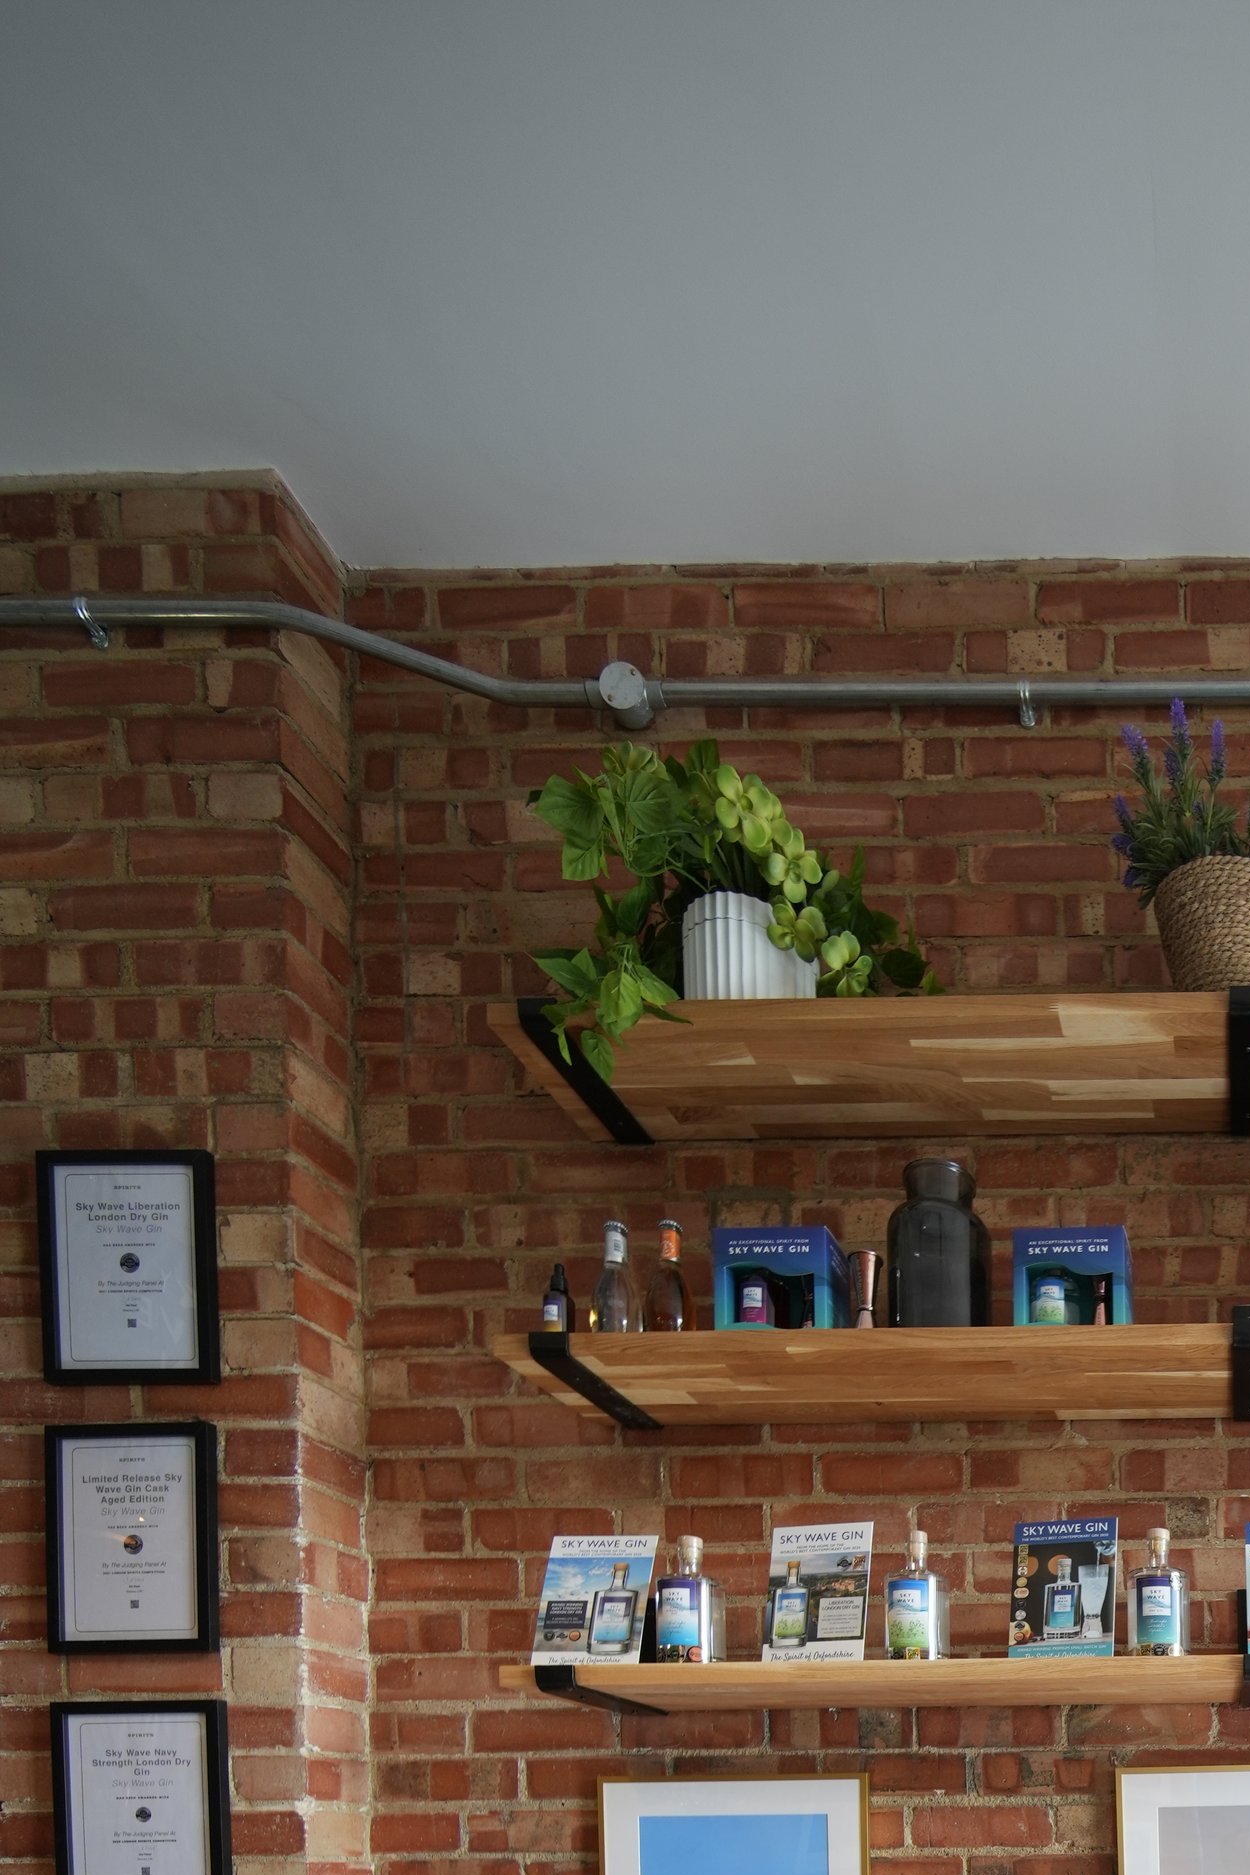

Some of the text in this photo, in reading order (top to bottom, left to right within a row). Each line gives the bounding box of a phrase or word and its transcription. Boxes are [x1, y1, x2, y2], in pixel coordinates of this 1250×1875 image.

[75, 1202, 180, 1212] Sky Wave Liberation
[88, 1213, 169, 1222] London Dry Gin
[96, 1224, 162, 1234] Sky Wave Gin
[728, 1245, 810, 1255] SKY WAVE GIN
[1028, 1247, 1048, 1255] SKY
[1052, 1245, 1083, 1253] WAVE
[82, 1475, 118, 1484] Limited
[165, 1474, 182, 1483] Sky
[96, 1484, 169, 1493] Wave Gin Cask
[101, 1495, 165, 1505] Aged Edition
[101, 1507, 165, 1517] Sky Wave Gin
[1023, 1522, 1108, 1536] SKY WAVE GIN
[780, 1530, 863, 1545] SKY WAVE GIN
[561, 1539, 648, 1548] SKY WAVE GIN
[106, 1749, 122, 1758] Sky
[155, 1749, 177, 1757] Navy
[92, 1758, 191, 1768] Strength London Dry
[134, 1768, 150, 1776] Gin
[112, 1779, 174, 1788] Sky Wave Gin
